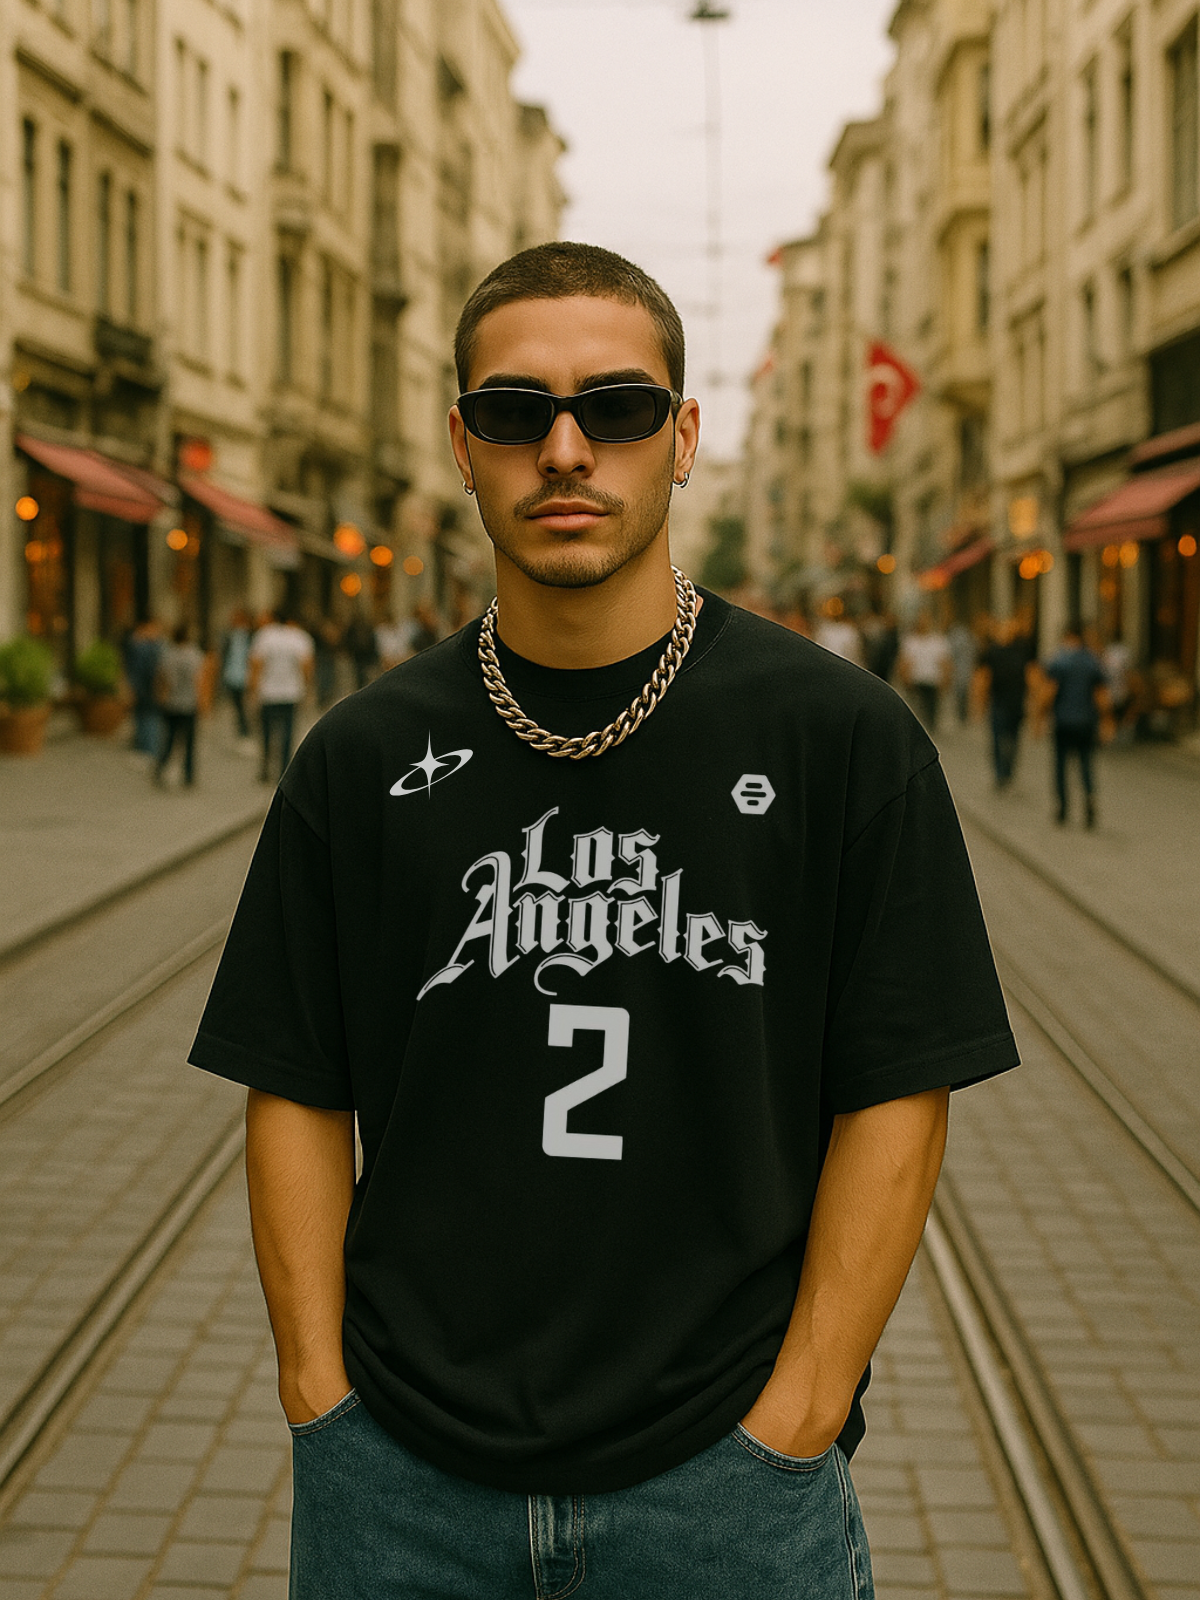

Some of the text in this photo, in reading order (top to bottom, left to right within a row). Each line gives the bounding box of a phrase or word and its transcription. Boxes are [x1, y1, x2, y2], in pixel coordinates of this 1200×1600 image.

[416, 850, 769, 1001] Angeles
[513, 807, 661, 896] Los
[541, 1003, 631, 1161] 2
